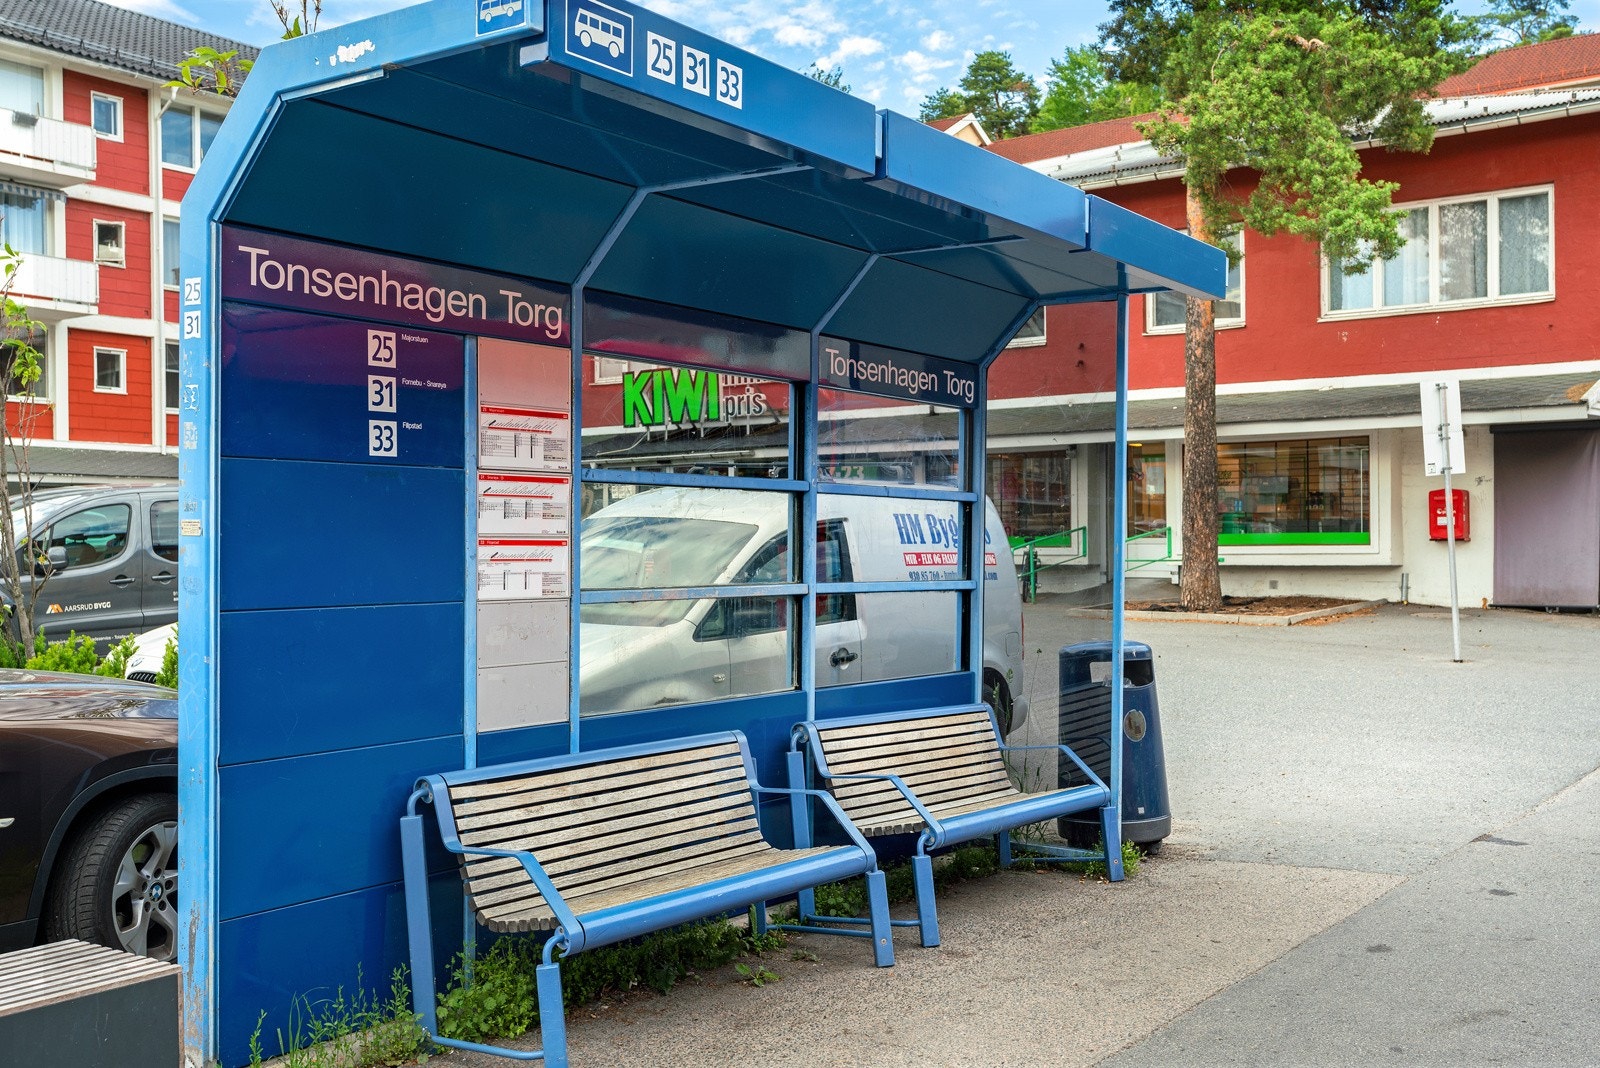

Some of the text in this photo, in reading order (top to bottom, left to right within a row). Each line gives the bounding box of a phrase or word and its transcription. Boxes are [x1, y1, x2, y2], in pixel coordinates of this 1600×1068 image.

[651, 38, 740, 102] 25 31 33
[185, 282, 201, 301] 25
[238, 245, 562, 339] Tonsenhagen Torg
[185, 315, 200, 335] 31
[371, 334, 429, 363] 25 Majorstuen
[825, 347, 975, 404] Tonsenhagen Torg
[371, 379, 393, 408] 31
[402, 378, 423, 387] Fornebu
[622, 367, 720, 428] KIWI
[723, 386, 767, 424] pris
[372, 424, 394, 453] 33
[892, 513, 927, 545] HM
[904, 553, 919, 565] MUR
[933, 553, 942, 565] OG
[64, 601, 112, 613] AARSRUD BYGG
